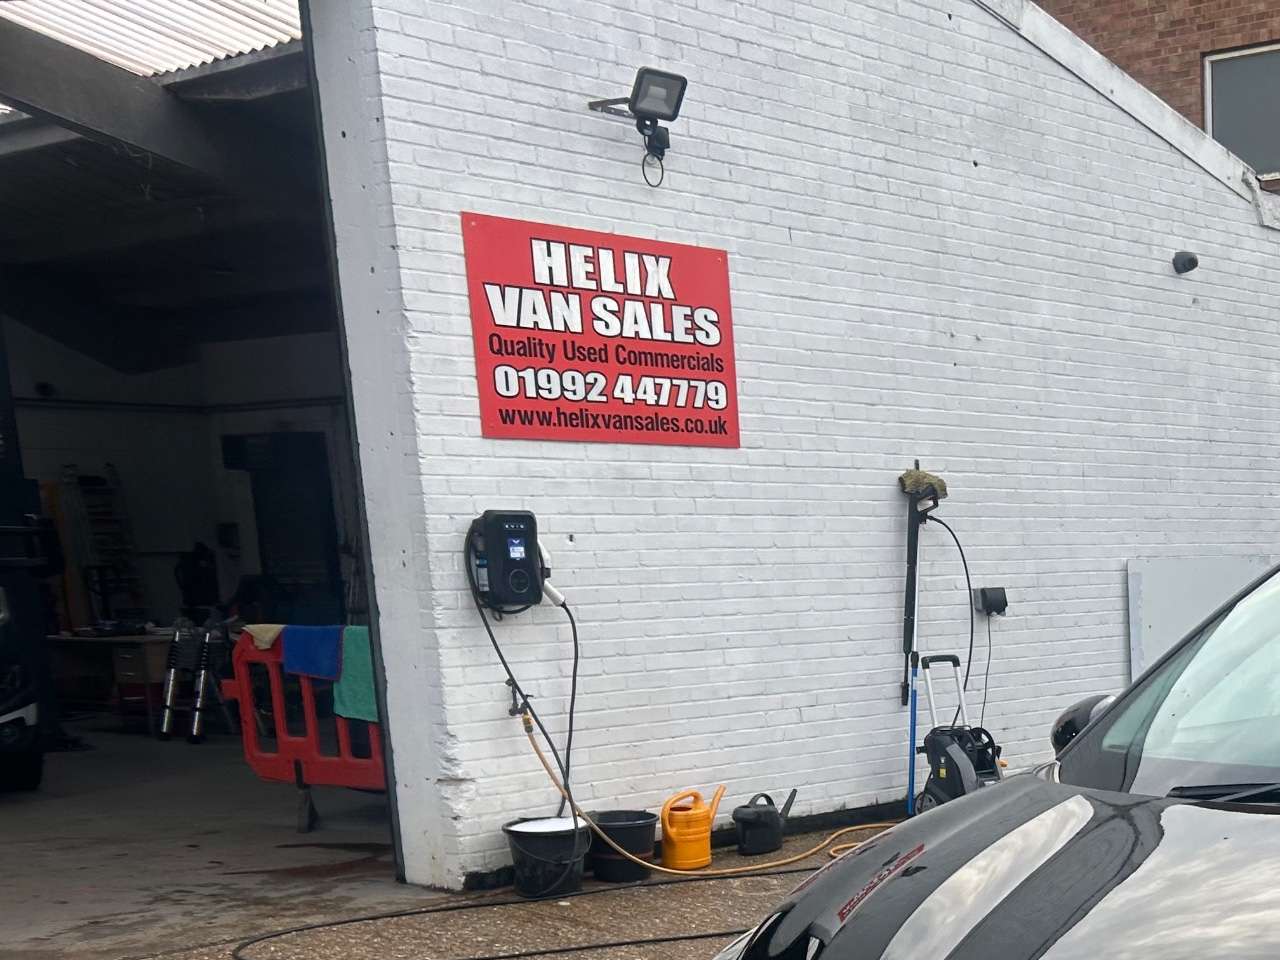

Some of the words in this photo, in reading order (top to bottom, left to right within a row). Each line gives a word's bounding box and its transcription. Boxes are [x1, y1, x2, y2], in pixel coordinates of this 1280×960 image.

[530, 237, 677, 300] HELIX
[484, 283, 584, 334] VAN
[590, 295, 722, 347] SALES
[488, 333, 556, 363] Quality
[563, 340, 608, 364] Used
[615, 344, 725, 373] Commercials
[493, 364, 608, 403] 01992
[612, 374, 728, 410] 447779
[498, 407, 728, 436] www.helixvansales.co.uk
